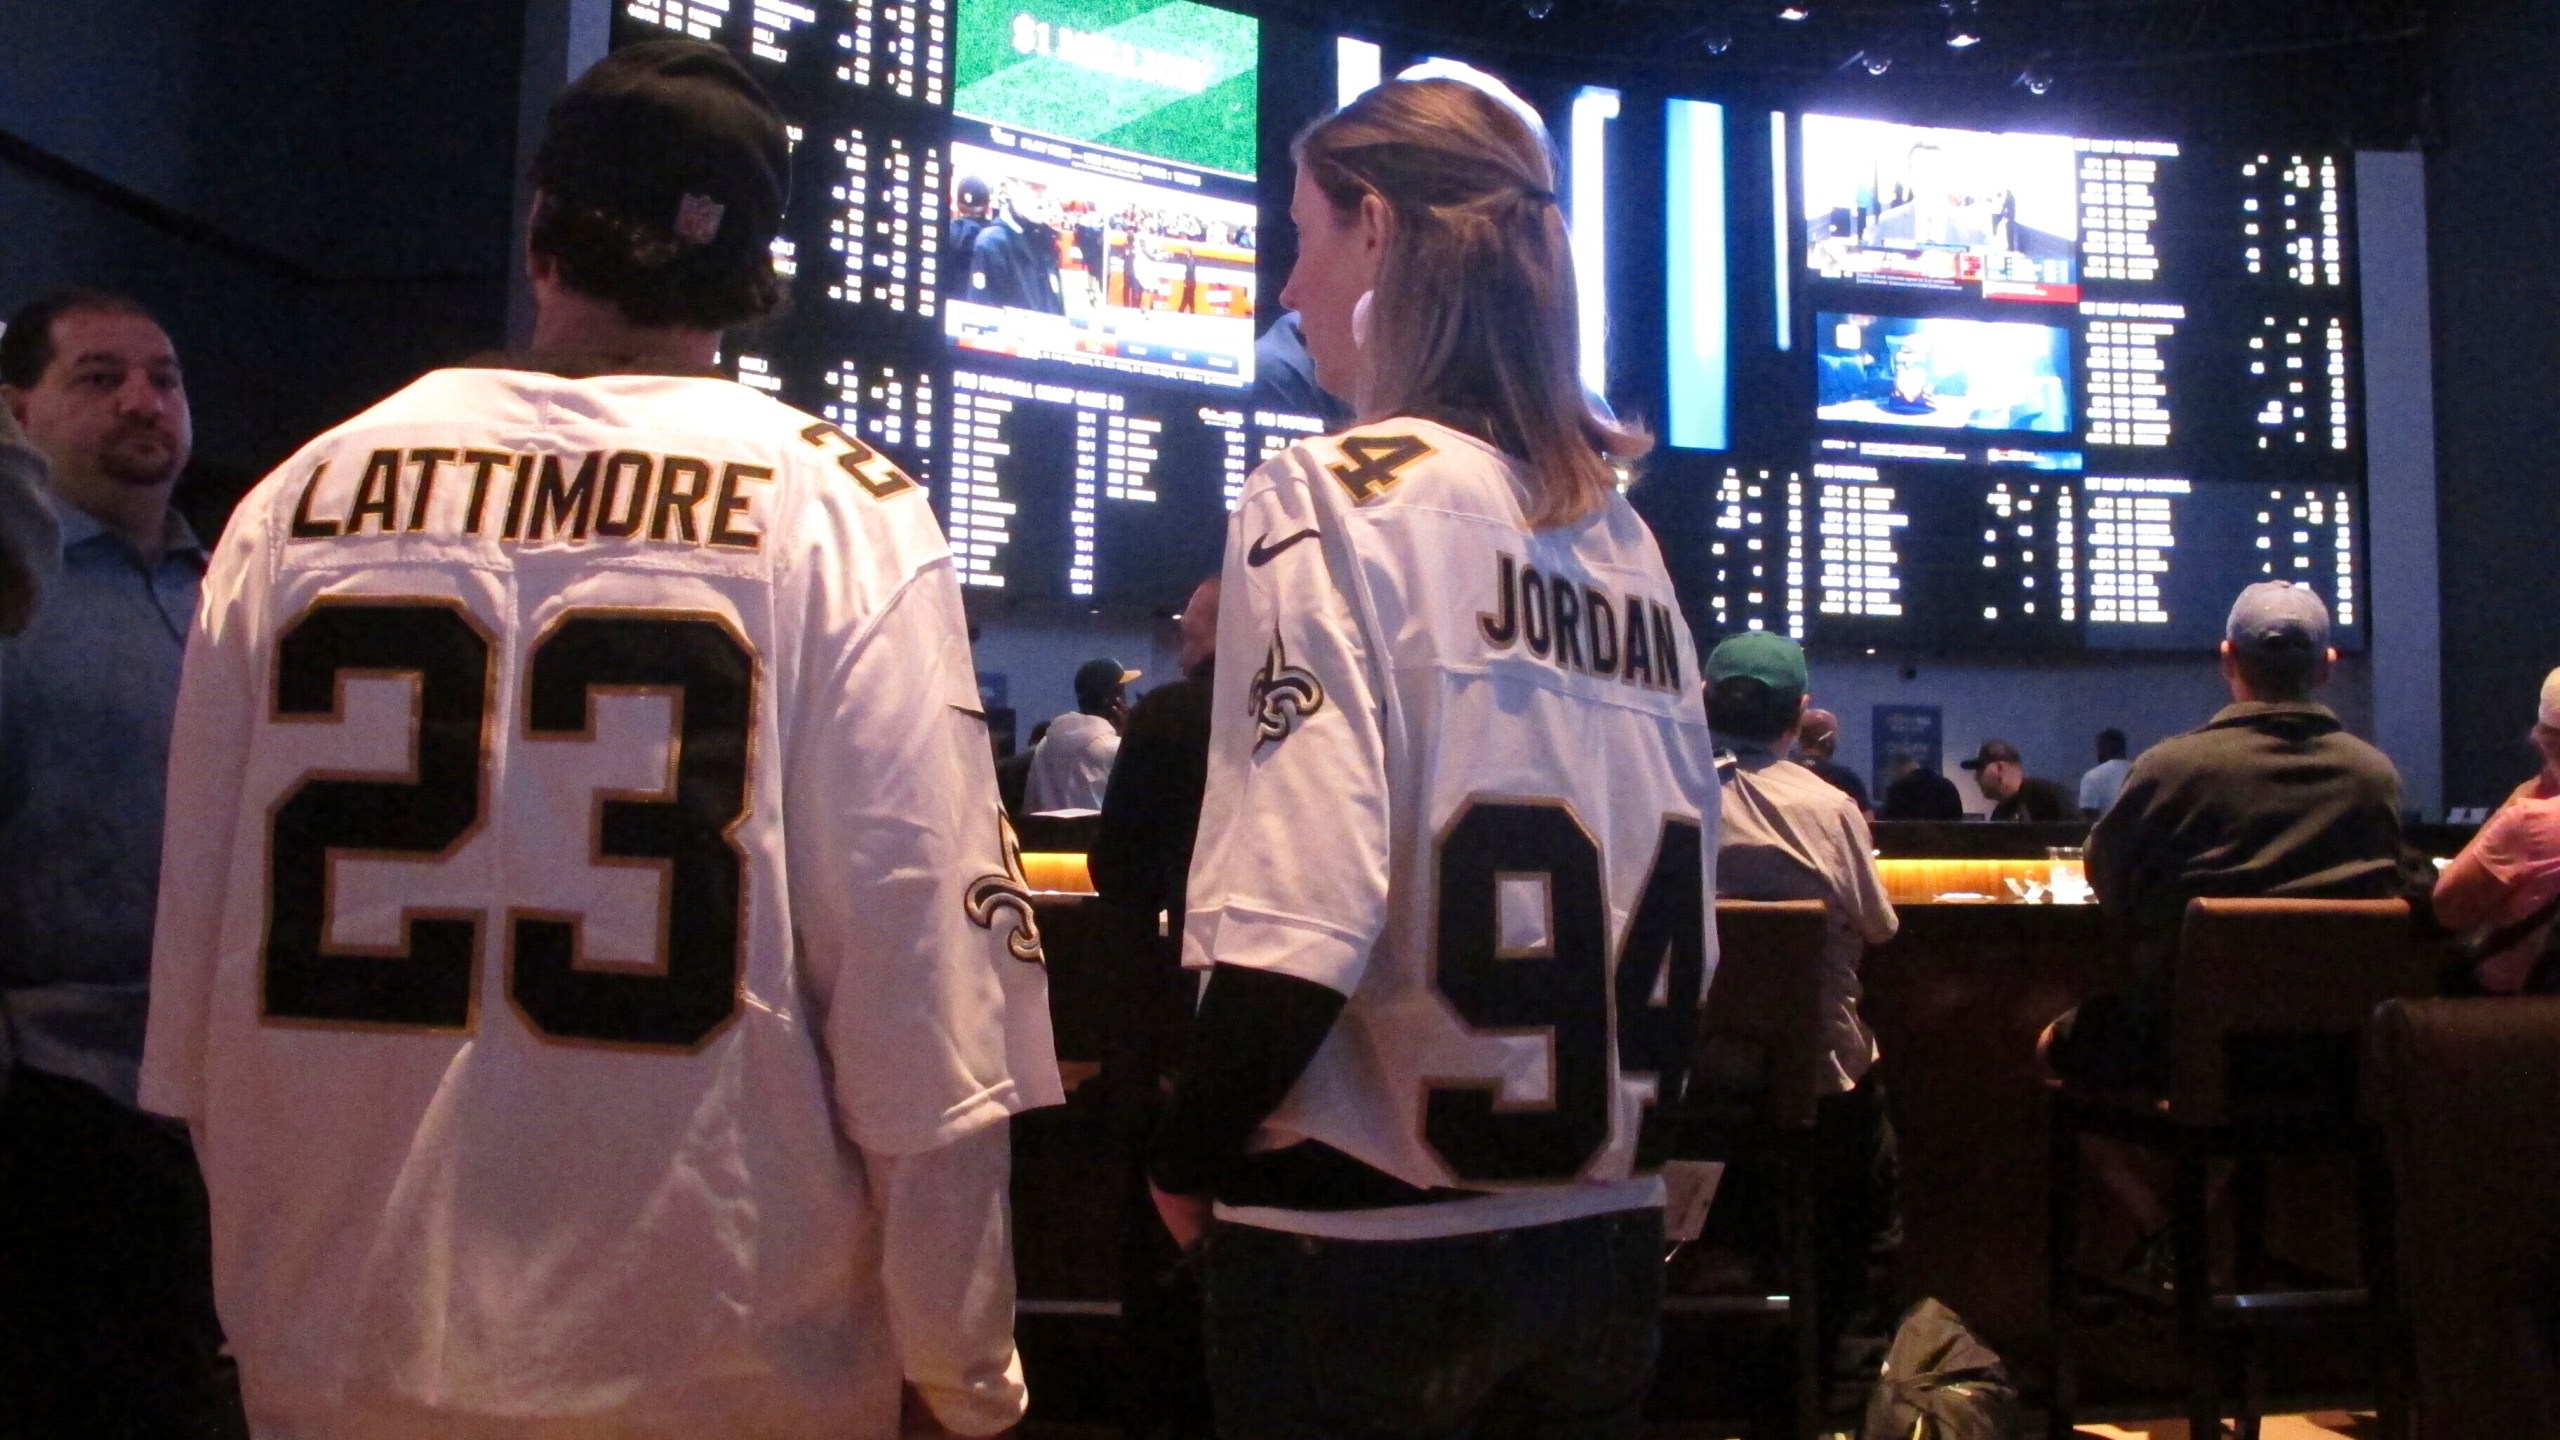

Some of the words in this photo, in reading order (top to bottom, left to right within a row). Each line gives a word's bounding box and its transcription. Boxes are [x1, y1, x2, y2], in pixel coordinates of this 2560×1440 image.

[954, 370, 978, 390] PRO
[979, 375, 1034, 399] FOOTBALL
[1277, 414, 1324, 433] FOOTBALL
[290, 446, 776, 553] LATTIMORE
[799, 422, 920, 503] 2
[1325, 433, 1441, 505] 4
[1476, 548, 1683, 696] JORDAN
[260, 594, 766, 1055] 23
[1414, 789, 1708, 1188] 94
